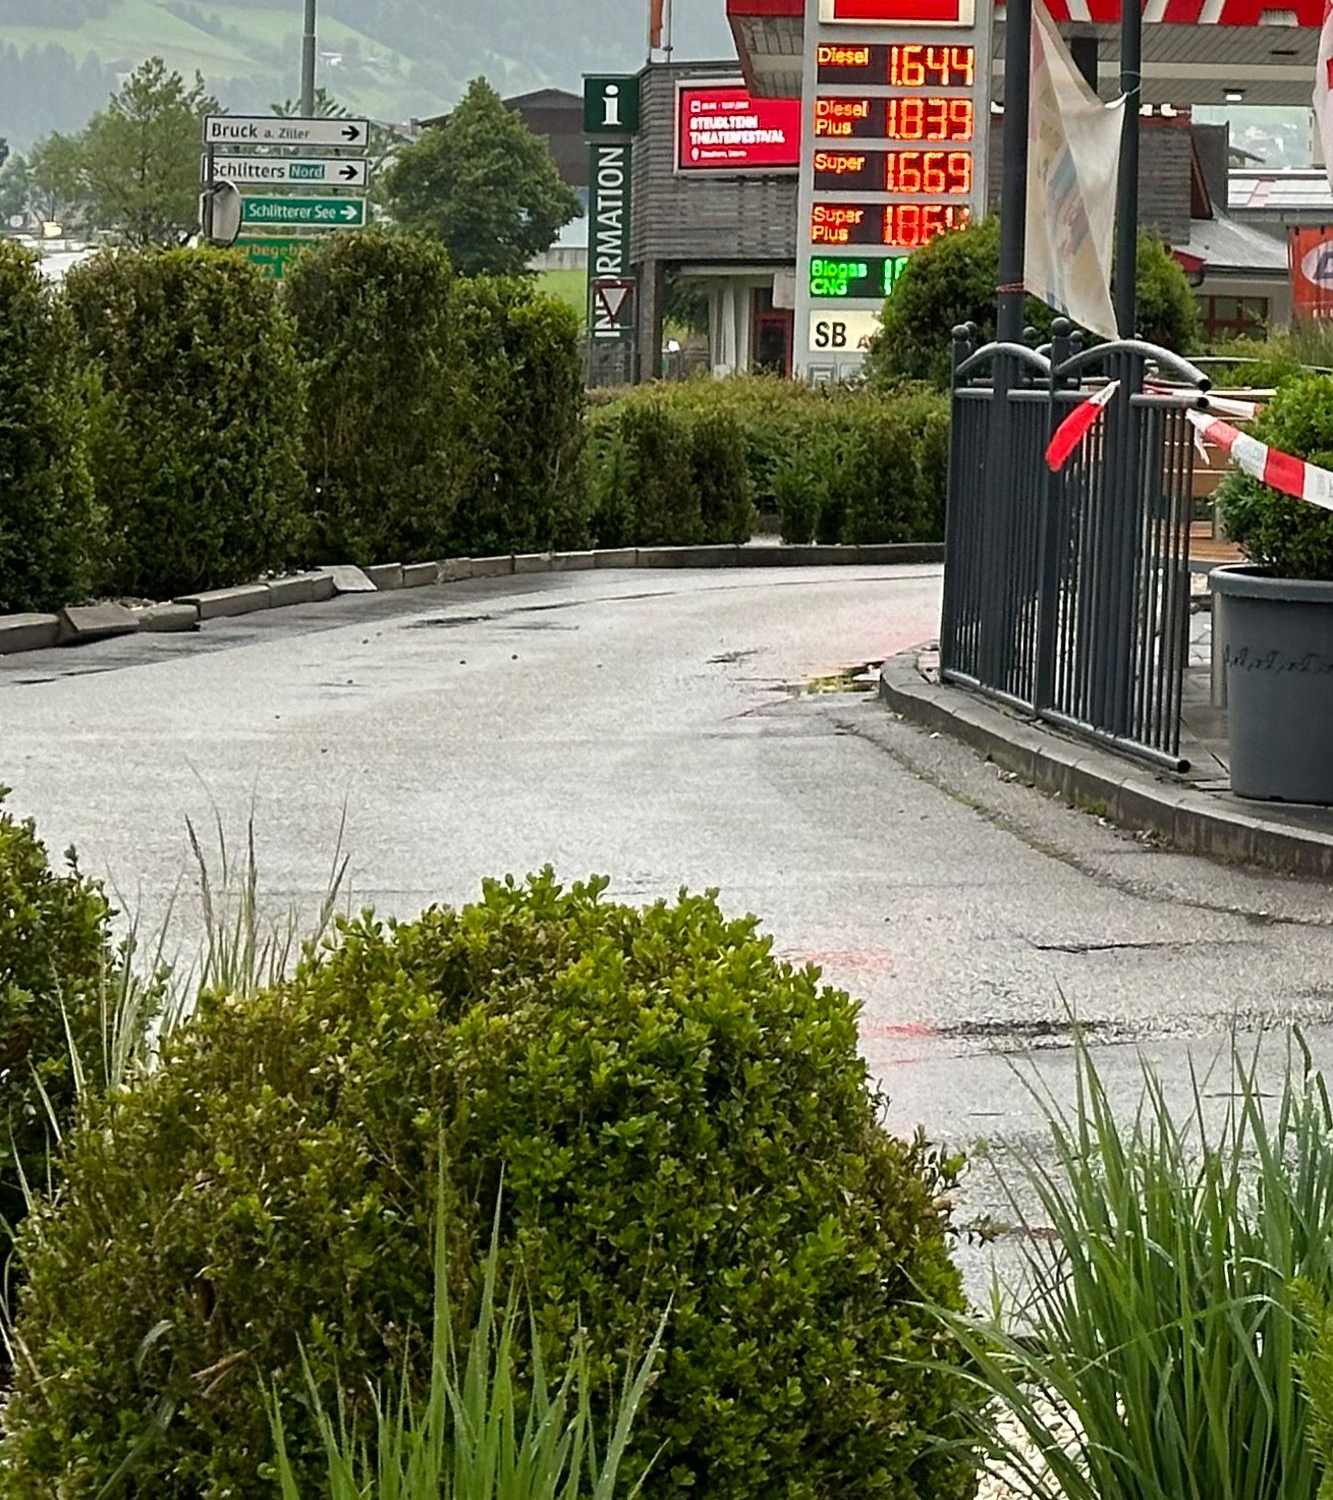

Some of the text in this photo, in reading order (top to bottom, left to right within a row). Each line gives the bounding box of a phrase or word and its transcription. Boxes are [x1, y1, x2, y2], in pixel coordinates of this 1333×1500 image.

[818, 45, 974, 86] Diesel 1.644
[815, 119, 852, 135] Plus
[816, 99, 973, 141] Diesel 1.839
[212, 123, 311, 140] Bruck a. Ziller
[212, 162, 325, 180] Schlitters Nord
[814, 152, 972, 194] Super 1.669
[249, 203, 336, 219] Schlitterer See
[812, 206, 864, 226] Super
[811, 225, 848, 241] Plus
[811, 260, 868, 279] Biogas
[810, 278, 848, 296] CNG
[815, 321, 847, 348] SB
